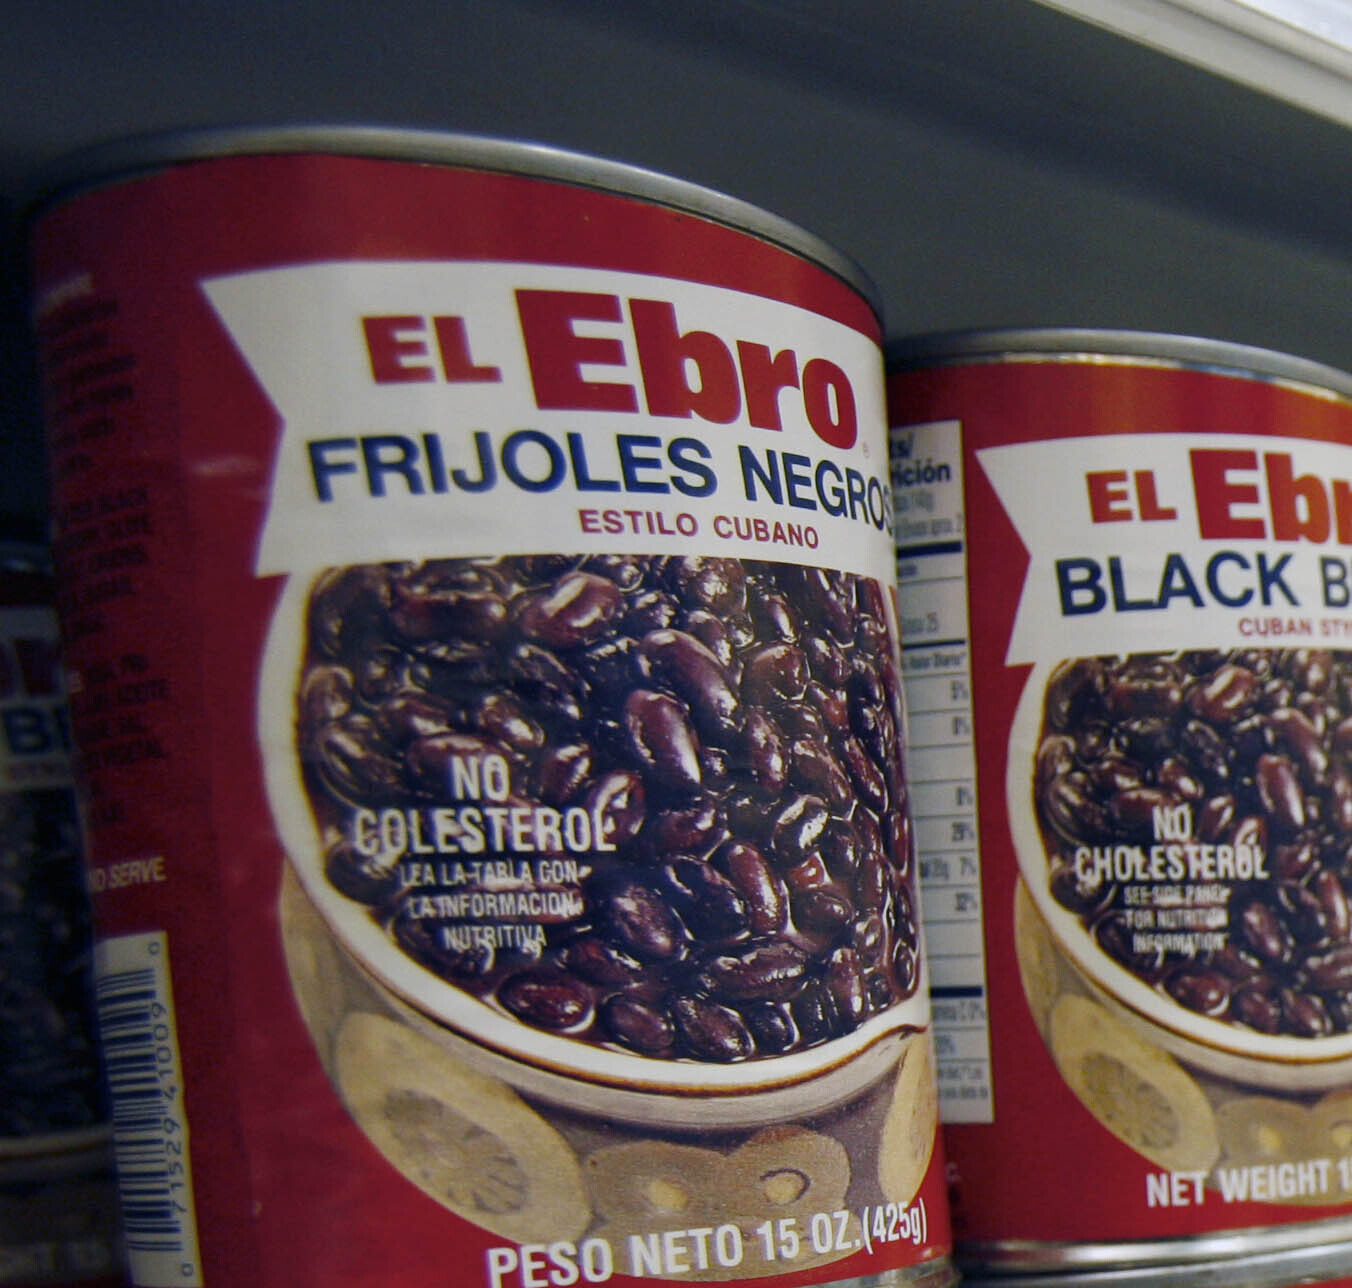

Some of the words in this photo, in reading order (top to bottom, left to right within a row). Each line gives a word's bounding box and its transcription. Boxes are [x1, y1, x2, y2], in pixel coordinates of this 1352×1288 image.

[361, 315, 502, 385] EL
[513, 288, 858, 450] Ebro
[307, 428, 718, 503] FRIJOLES
[1085, 470, 1178, 523] EL
[578, 508, 699, 540] ESTILO
[713, 516, 819, 551] CUBANO
[1055, 550, 1302, 617] BLACK
[1237, 618, 1312, 638] CUBAN
[451, 754, 510, 801] NO
[353, 806, 616, 855] COLESTEROL
[1152, 803, 1193, 842] NO
[1075, 845, 1270, 882] CHOLESTEROL
[1145, 1173, 1208, 1209] NET
[1216, 1158, 1331, 1203] WEIGHT
[630, 1223, 744, 1278] NETO
[755, 1218, 800, 1260] 15
